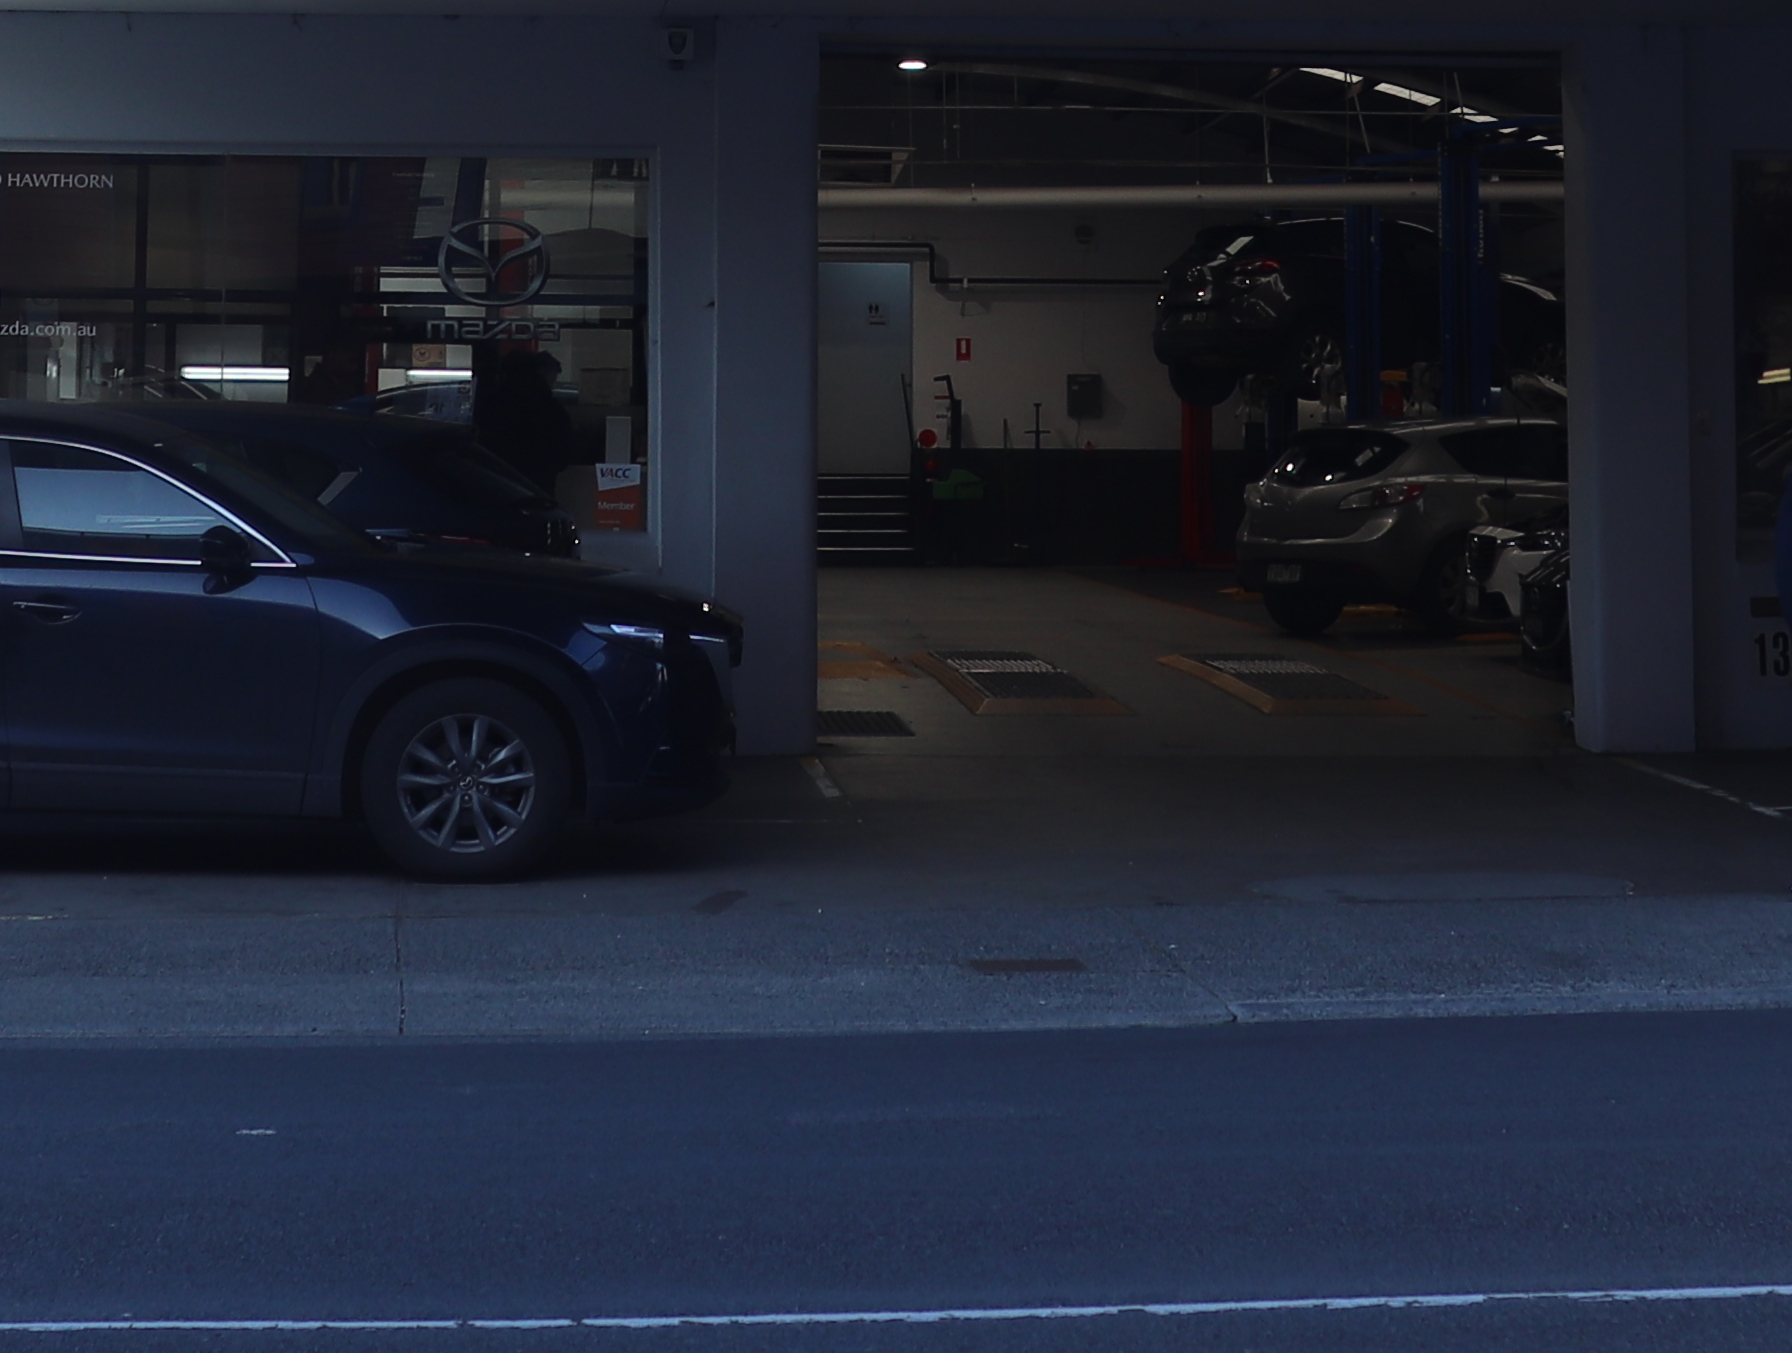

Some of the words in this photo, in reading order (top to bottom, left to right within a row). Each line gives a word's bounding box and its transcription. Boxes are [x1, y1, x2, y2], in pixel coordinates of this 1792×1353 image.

[8, 173, 114, 189] HAWTHORN
[599, 467, 631, 479] VACC
[597, 501, 635, 510] Member
